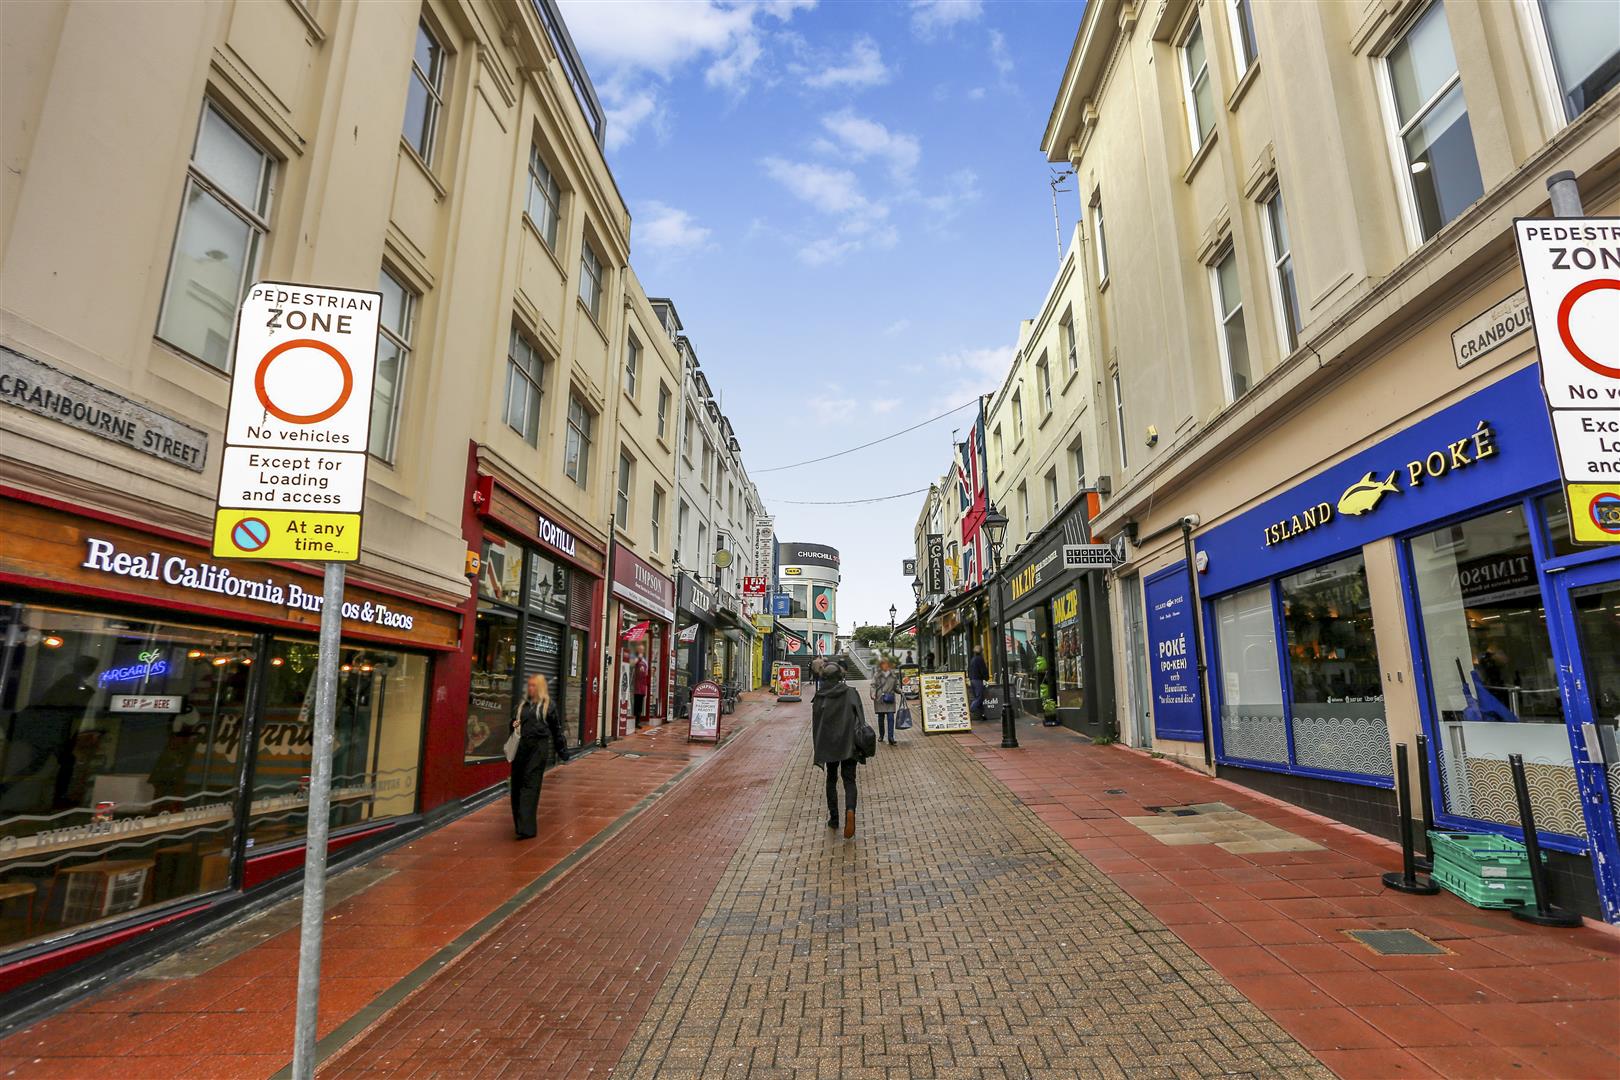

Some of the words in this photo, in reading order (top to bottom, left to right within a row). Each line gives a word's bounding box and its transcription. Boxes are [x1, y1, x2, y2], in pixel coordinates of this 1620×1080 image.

[1549, 246, 1620, 270] ZON
[252, 289, 372, 311] PEDESTRIAN
[266, 308, 352, 335] ZONE
[1568, 384, 1598, 399] No
[1605, 387, 1620, 399] v
[0, 374, 137, 441] CRANBOURNE
[143, 429, 201, 464] STREET
[1580, 416, 1619, 432] Exc
[247, 425, 272, 439] No
[280, 429, 350, 443] vehicles
[1599, 437, 1620, 452] Lo
[249, 454, 311, 471] Except
[318, 457, 342, 471] for
[259, 471, 329, 489] Loading
[1264, 502, 1332, 547] ISLAND
[1406, 420, 1494, 487] POKÉ
[242, 489, 275, 501] and
[282, 492, 341, 504] access
[286, 520, 307, 534] At
[313, 524, 345, 537] any
[539, 516, 575, 558] TORTILLA
[294, 538, 334, 551] time
[797, 551, 832, 560] CHURCHILL
[83, 537, 160, 581] Real
[163, 556, 283, 605] California
[288, 584, 360, 619] Buros
[360, 602, 374, 621] &
[374, 603, 414, 630] Tacos
[634, 563, 662, 594] TIMPSON
[1159, 633, 1186, 658] POKÉ
[98, 660, 167, 689] ARGARIAS
[472, 698, 502, 710] TORTILLA
